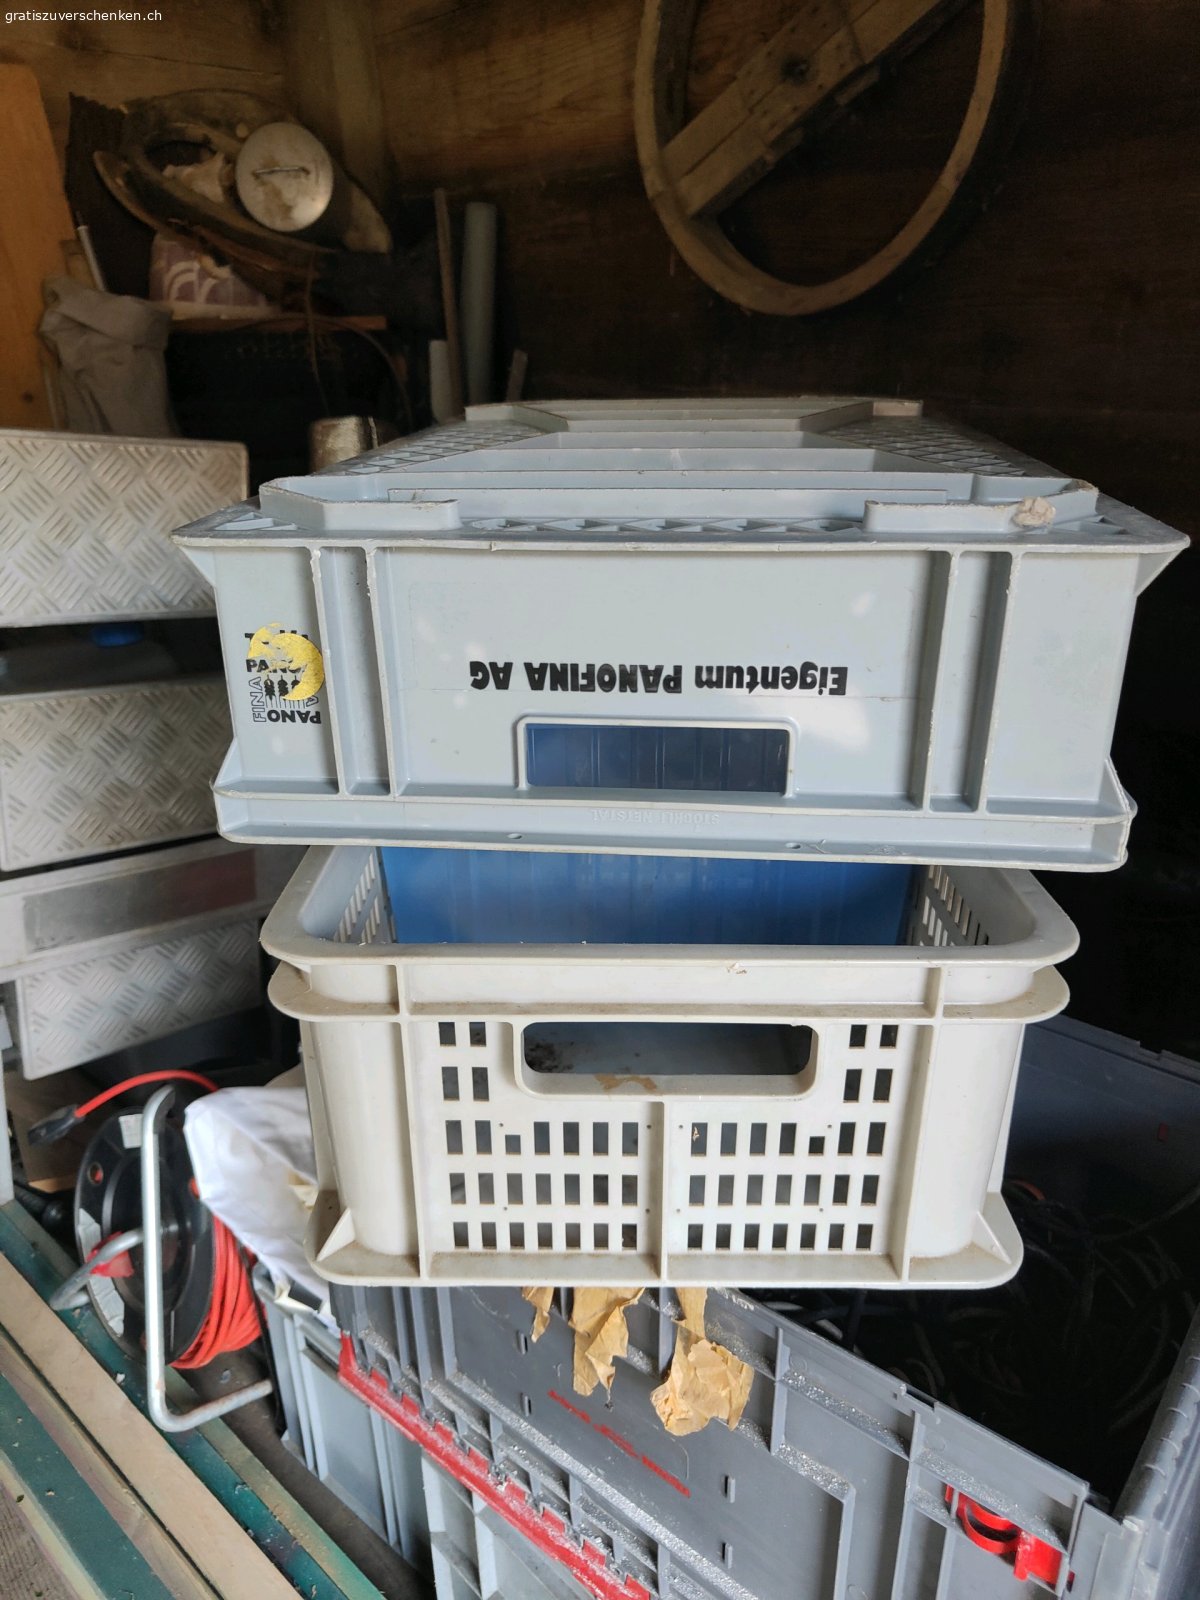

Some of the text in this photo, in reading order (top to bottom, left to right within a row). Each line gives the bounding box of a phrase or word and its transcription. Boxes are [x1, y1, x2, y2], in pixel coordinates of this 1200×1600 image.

[470, 661, 847, 695] Eigentum PANOFINA AG
[249, 676, 267, 723] FINA
[267, 710, 322, 725] PANO
